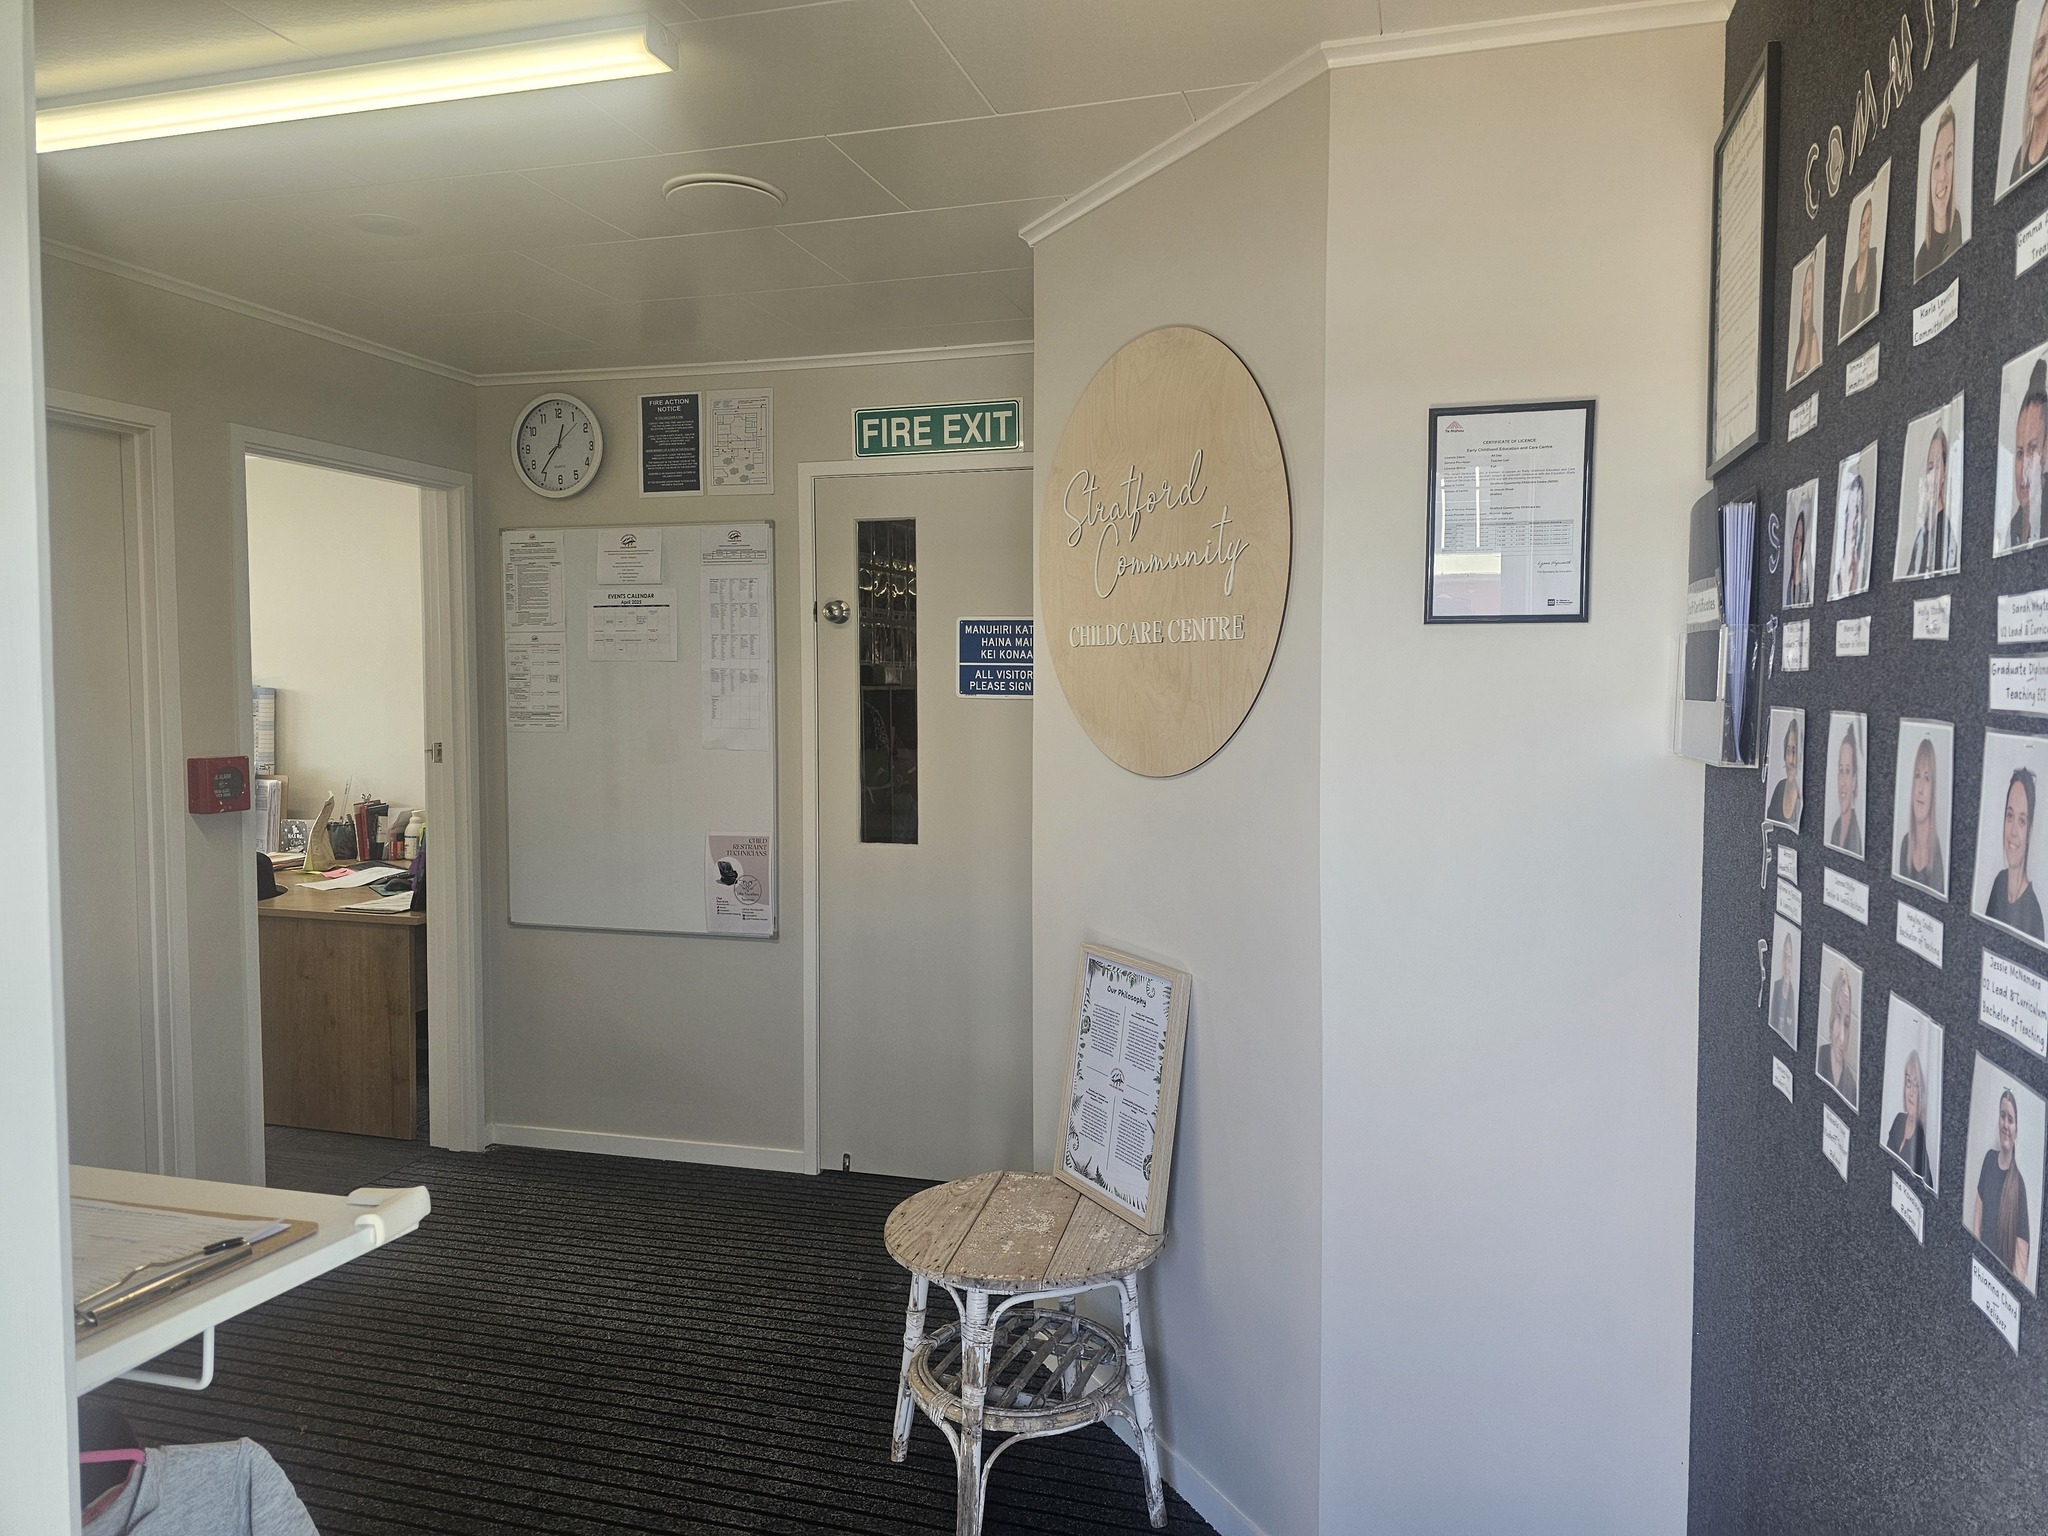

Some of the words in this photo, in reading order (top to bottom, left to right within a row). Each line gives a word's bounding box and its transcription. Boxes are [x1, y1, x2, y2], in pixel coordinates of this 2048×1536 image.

[2018, 221, 2042, 247] Gemma
[1920, 302, 1936, 319] Karla
[540, 414, 546, 424] 11
[554, 408, 562, 418] 12
[529, 427, 536, 436] 10
[583, 423, 588, 433] 2
[862, 416, 932, 448] FIRE
[943, 410, 1012, 444] EXIT
[526, 444, 530, 454] 9
[589, 440, 594, 451] 3
[531, 460, 536, 470] 8
[584, 457, 590, 466] 4
[558, 474, 563, 484] 6
[574, 470, 578, 480] 5
[1064, 448, 1207, 547] Stratford
[1094, 506, 1249, 598] Community
[2012, 600, 2030, 614] Sarah
[965, 625, 1012, 634] MANUHIRI
[1069, 621, 1163, 647] CHILDCARE
[1168, 614, 1244, 642] CENTRE
[2008, 624, 2022, 637] Lead
[982, 638, 1012, 646] HAINA
[981, 650, 996, 658] KEI
[975, 670, 994, 678] ALL
[1992, 662, 2026, 676] Graduate
[970, 682, 1006, 690] PLEASE
[1009, 682, 1032, 690] SIGN
[2005, 686, 2035, 706] Teaching
[1990, 957, 2008, 974] Jessie
[2010, 965, 2041, 991] McNamara
[1107, 986, 1116, 994] Our
[1118, 990, 1146, 1008] Philosophy
[1992, 981, 2008, 1000] Lead
[2016, 993, 2048, 1020] Curriculum
[1982, 1000, 2009, 1024] Bachelor
[2011, 1016, 2018, 1032] of
[2020, 1020, 2044, 1052] Teaching
[1974, 1266, 2000, 1298] Rhianna
[2001, 1293, 2018, 1320] Chard
[1986, 1300, 2006, 1330] Reliever
